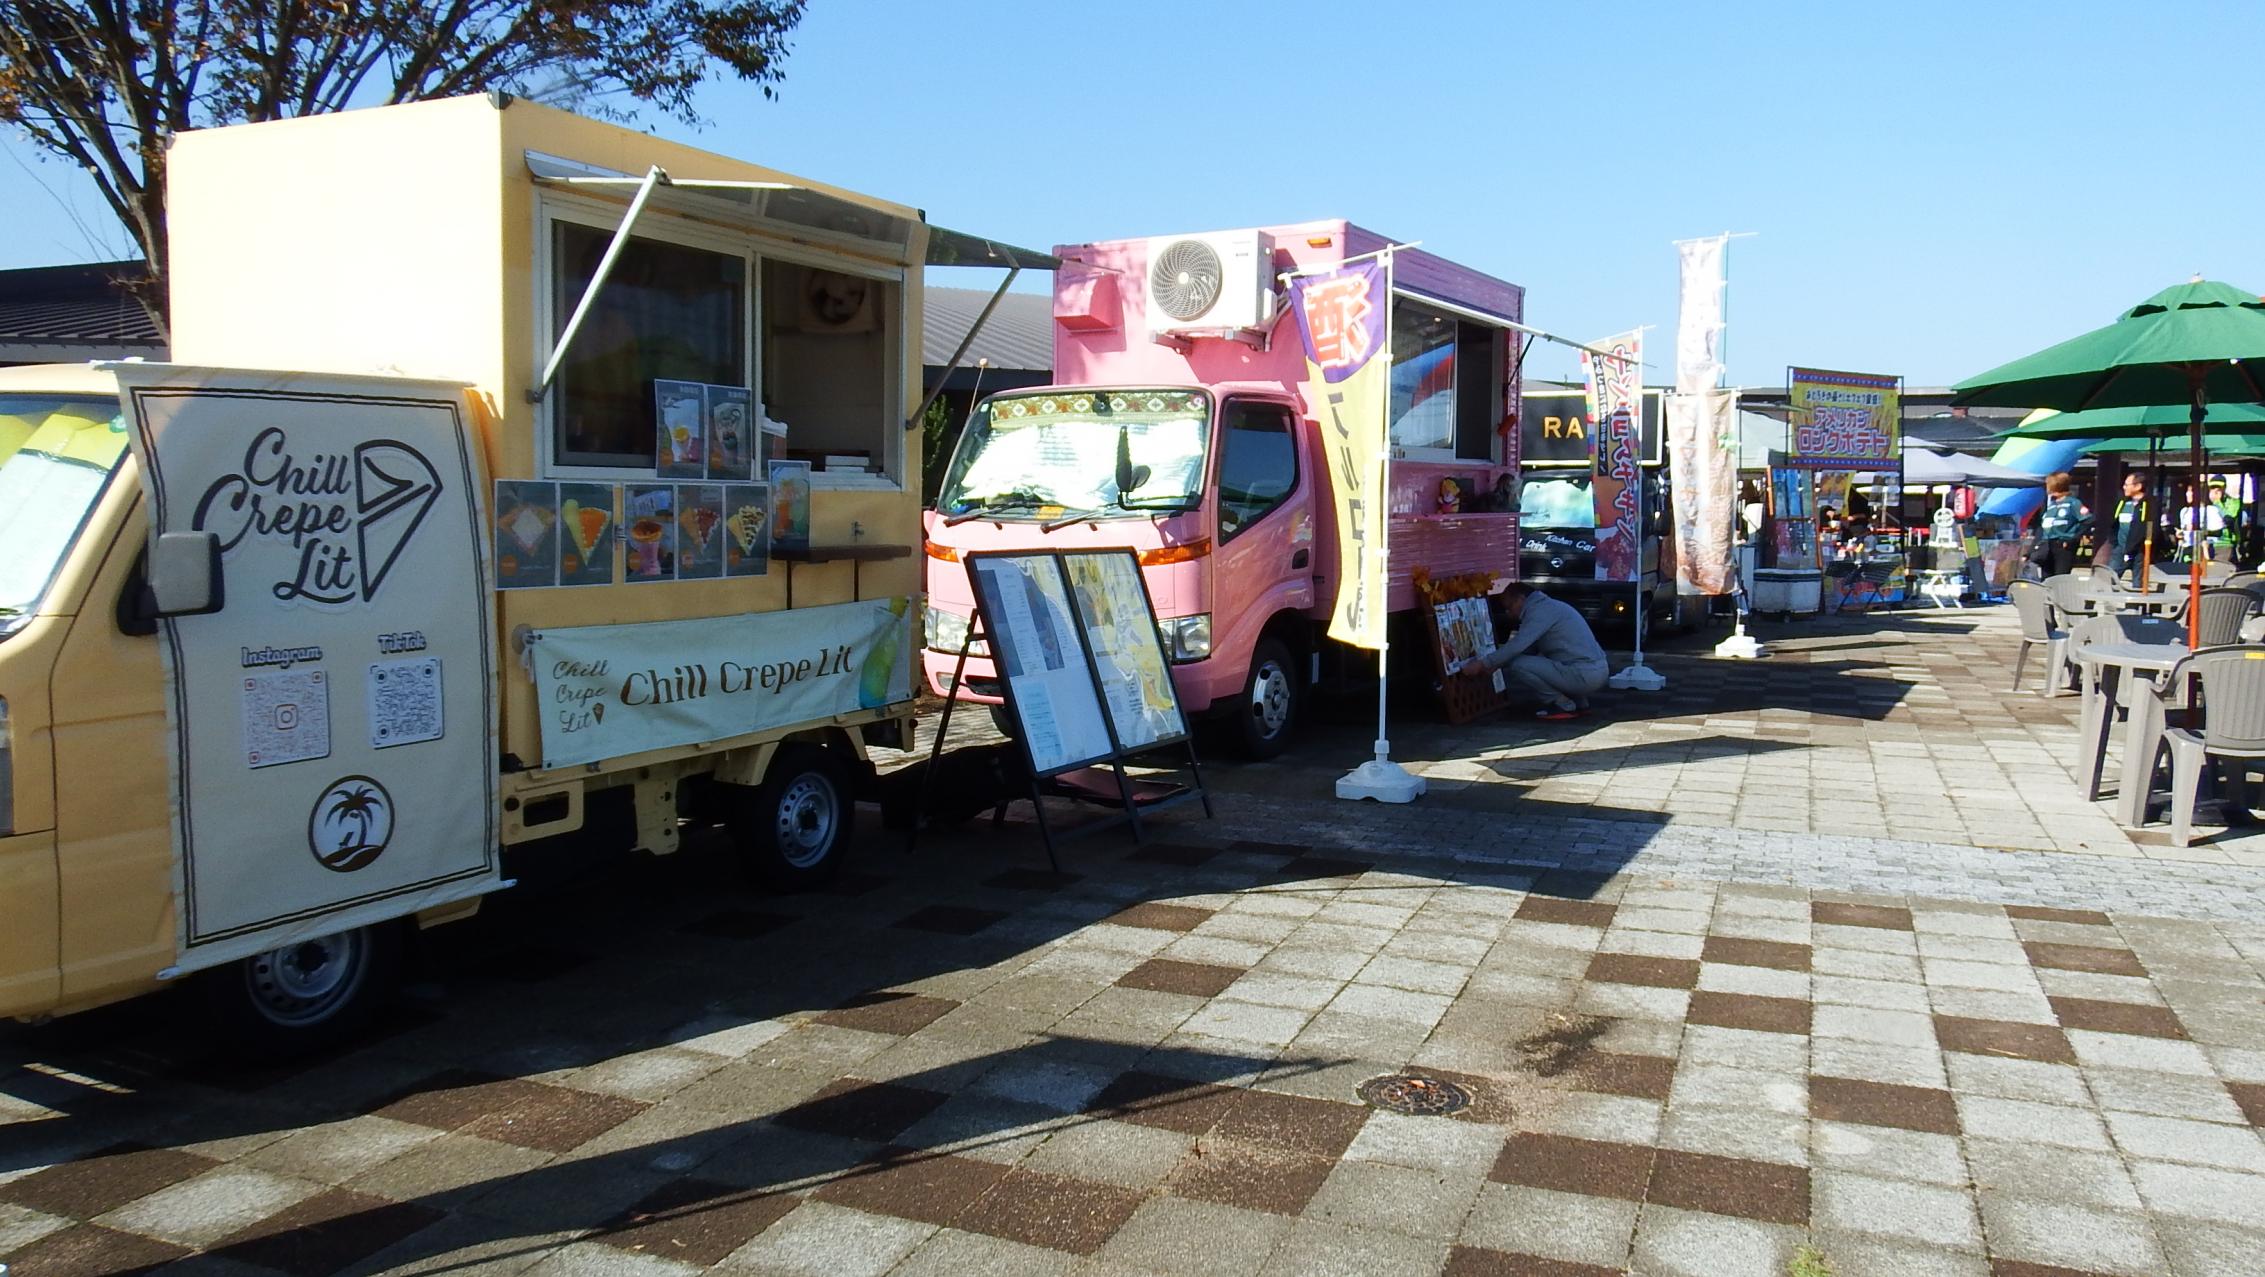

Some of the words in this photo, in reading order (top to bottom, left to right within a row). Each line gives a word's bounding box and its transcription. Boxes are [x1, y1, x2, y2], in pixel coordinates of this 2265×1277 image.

[1544, 416, 1585, 439] RA
[1813, 407, 1872, 430] アメリカン
[1798, 426, 1889, 454] ロングポテト
[244, 427, 352, 495] Chill
[192, 473, 352, 553] Crepe
[1525, 539, 1549, 553] Drink
[1544, 534, 1574, 546] Kitchen
[1575, 540, 1597, 552] Car
[272, 538, 356, 604] Lit
[378, 630, 428, 653] TikTok
[241, 645, 323, 668] Instagram
[552, 659, 611, 681] Chill
[620, 664, 708, 707] Chill
[719, 659, 812, 695] Crepe
[815, 645, 855, 678] Lit
[555, 683, 607, 708] Crepe
[559, 709, 594, 734] Lit
